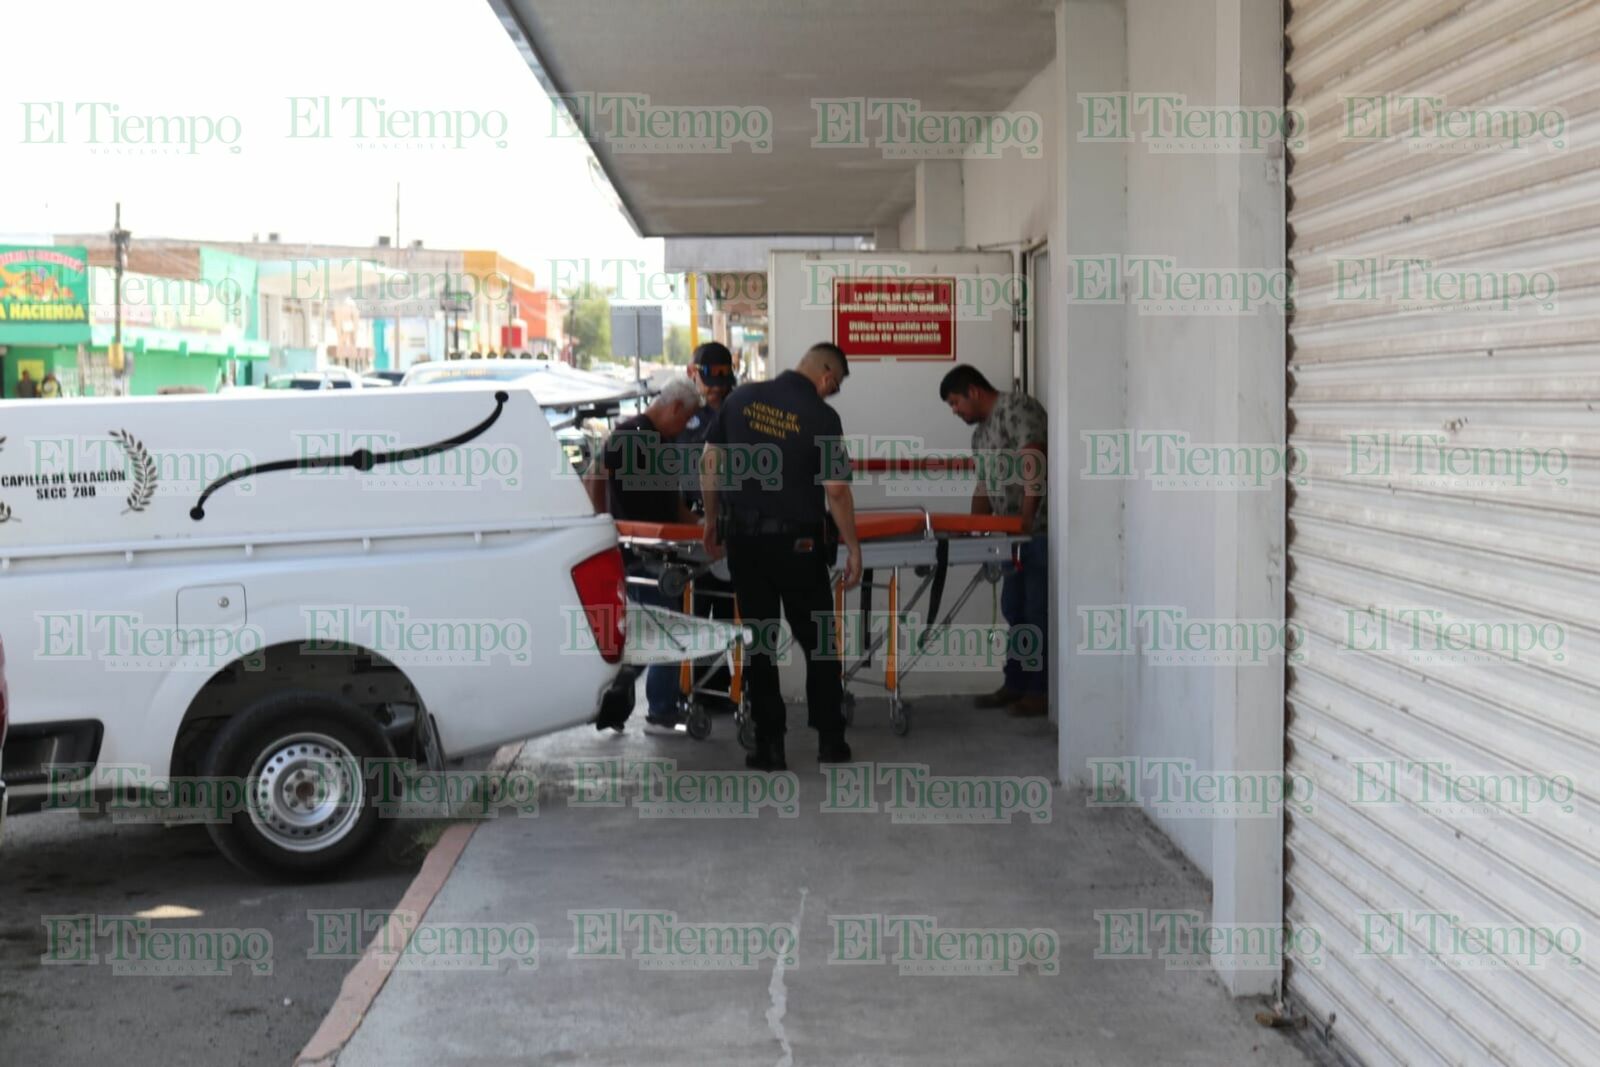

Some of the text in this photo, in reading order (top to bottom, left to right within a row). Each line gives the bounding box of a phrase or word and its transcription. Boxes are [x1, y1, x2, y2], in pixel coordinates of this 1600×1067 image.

[10, 303, 85, 320] HACIENDA
[1, 468, 126, 487] CAPILLA DE VELACIÓN
[36, 487, 67, 500] SECC
